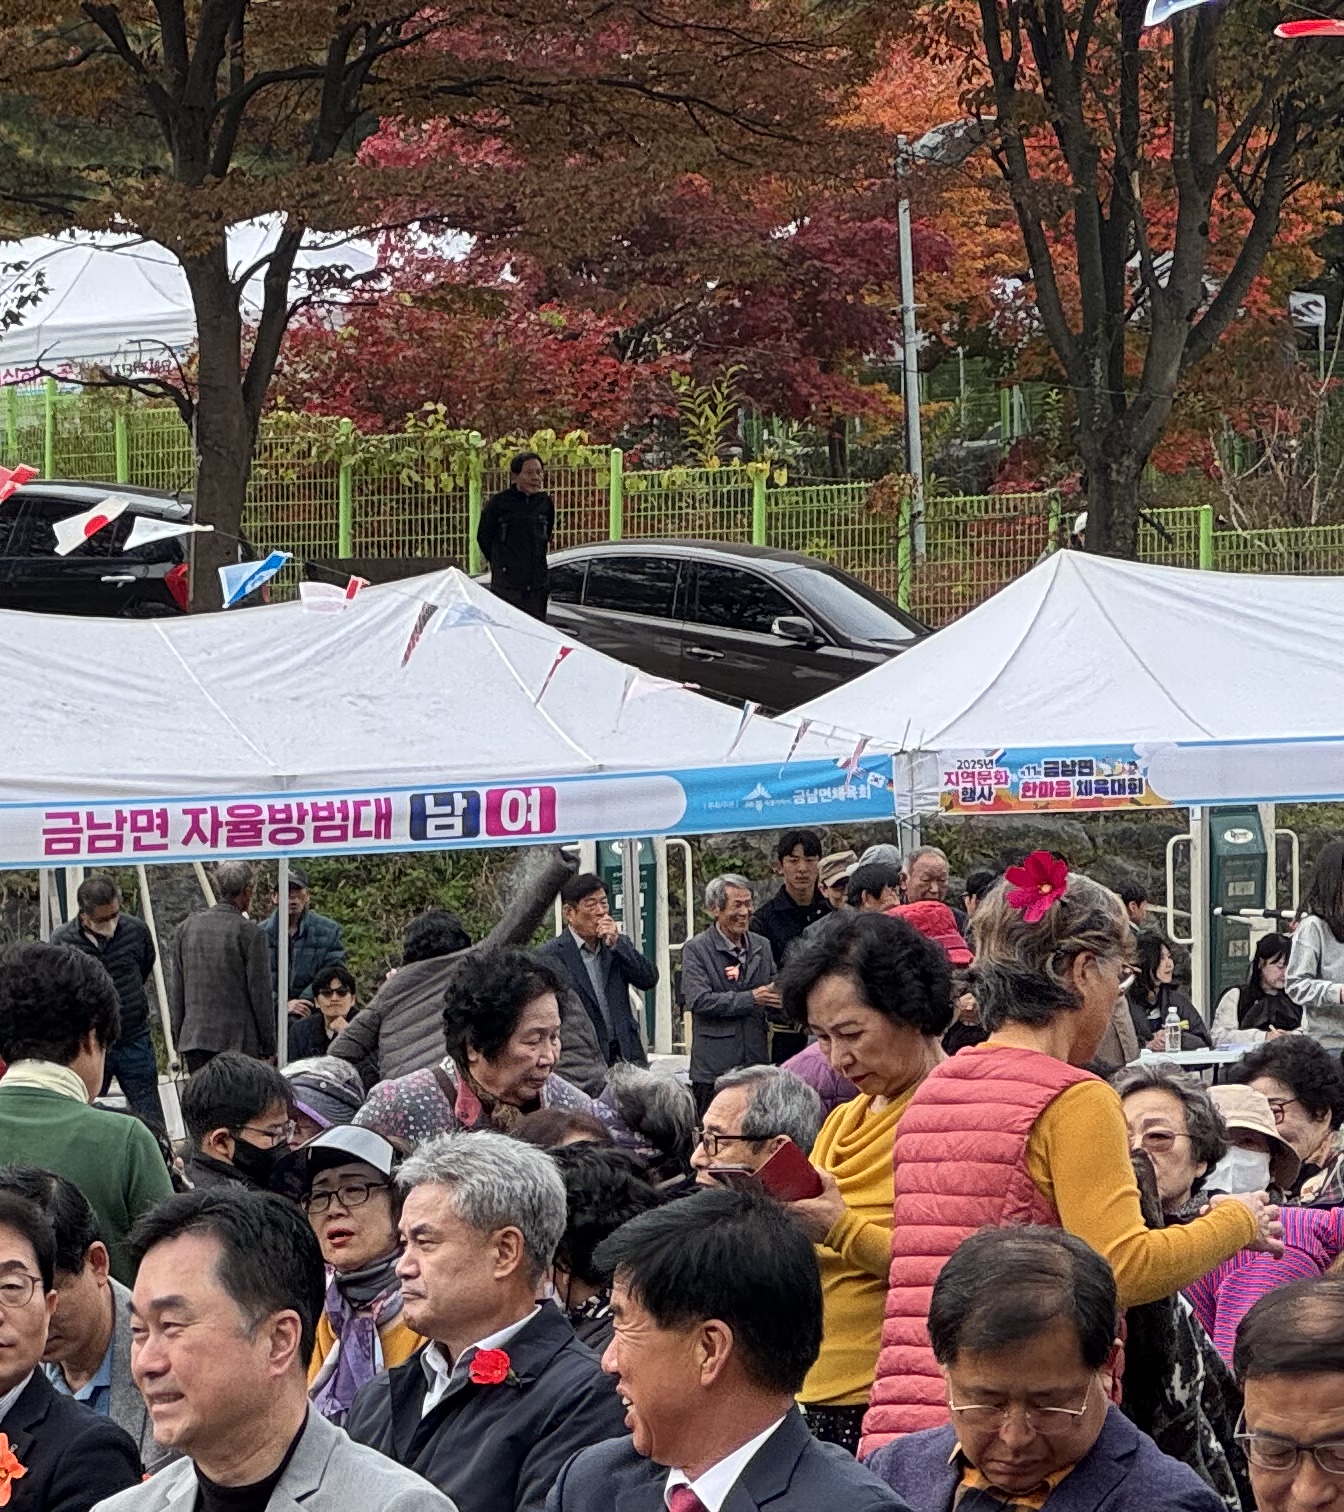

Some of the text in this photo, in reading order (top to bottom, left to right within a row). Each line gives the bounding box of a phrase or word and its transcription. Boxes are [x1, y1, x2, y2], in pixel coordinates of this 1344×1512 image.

[957, 759, 993, 770] 2025년
[1043, 759, 1094, 778] 금남면
[944, 770, 1009, 786] 지역문화
[961, 786, 994, 802] 행사
[1021, 777, 1144, 798] 한마음 체육대회
[42, 788, 545, 856] 금남면 자율방범대 남 여
